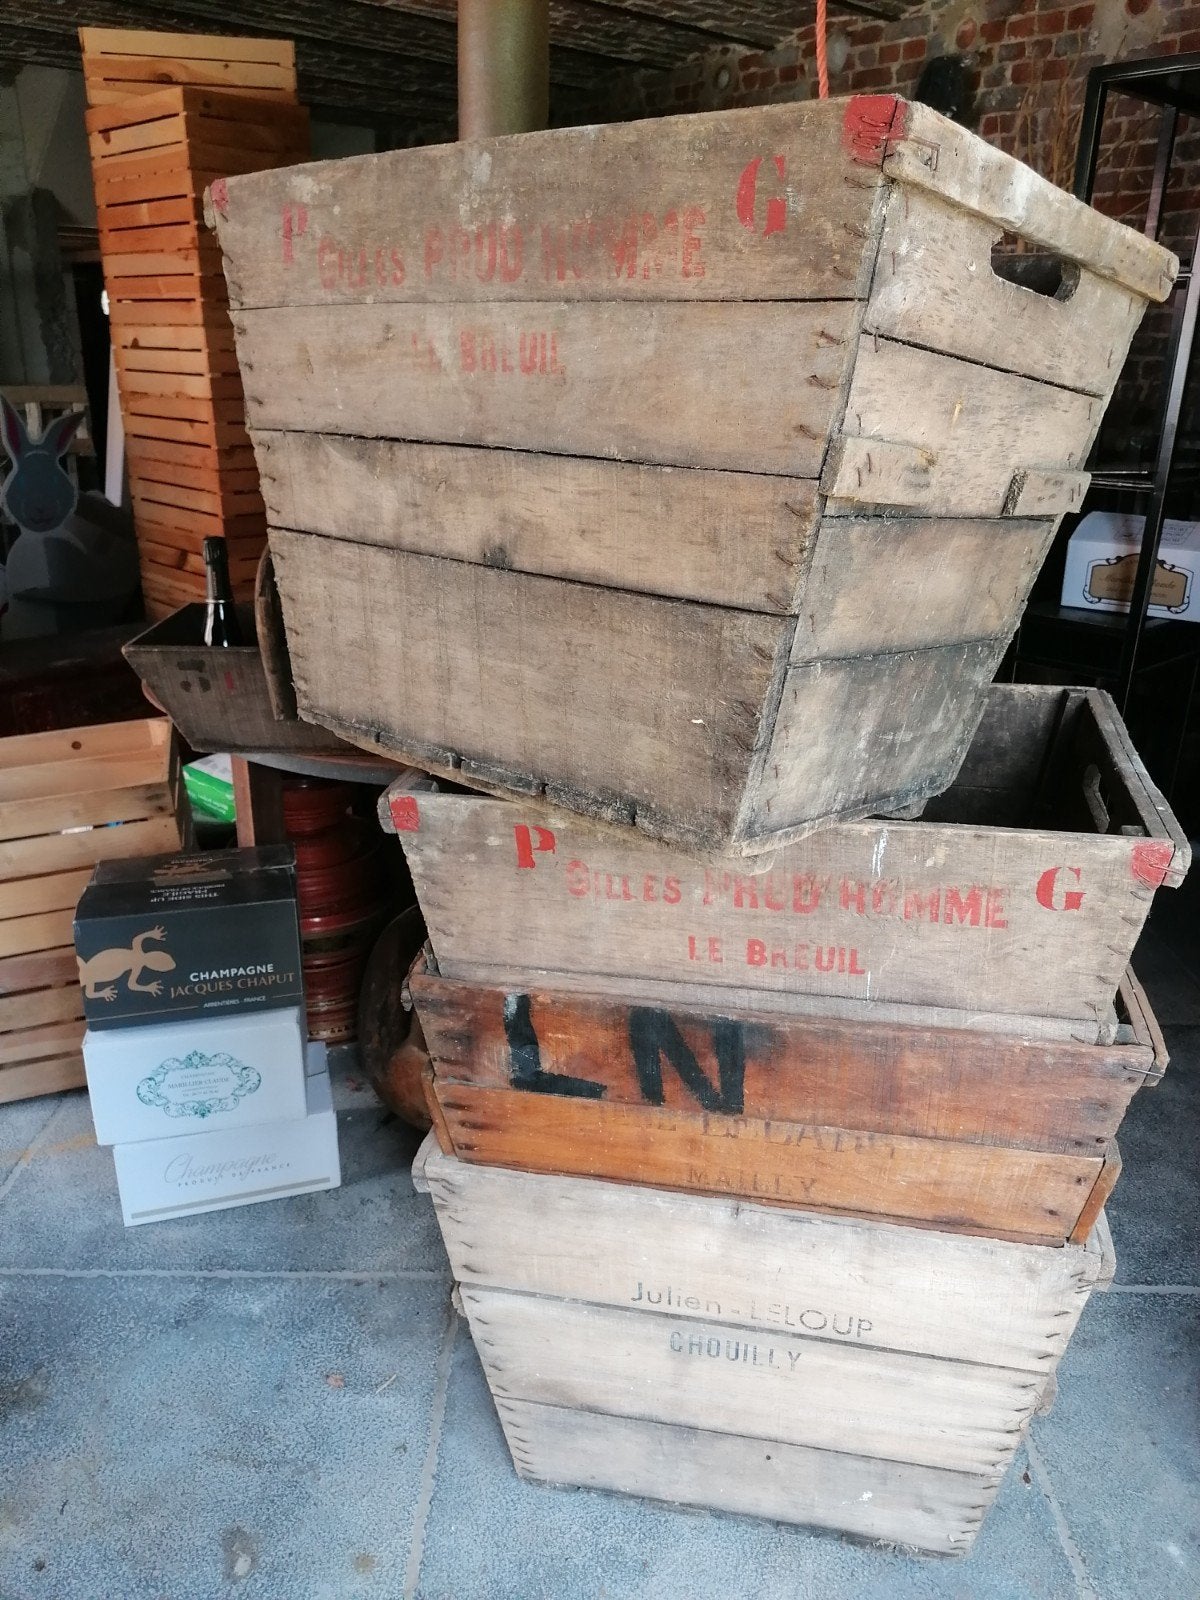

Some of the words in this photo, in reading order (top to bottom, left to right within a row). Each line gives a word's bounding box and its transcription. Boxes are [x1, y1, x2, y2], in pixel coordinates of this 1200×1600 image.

[736, 155, 787, 237] G
[513, 824, 556, 869] P
[566, 860, 682, 904] GILLES
[1035, 866, 1087, 912] G
[189, 963, 274, 982] CHAMPAGNE
[687, 935, 723, 963] LE
[746, 938, 866, 975] BREUIL
[170, 979, 233, 999] JACQUES
[237, 972, 295, 989] CHAPUT
[163, 1152, 278, 1183] Champagne
[631, 1281, 722, 1315] Julien
[751, 1299, 874, 1338] LELOUP
[669, 1330, 802, 1371] CHOUILLY
